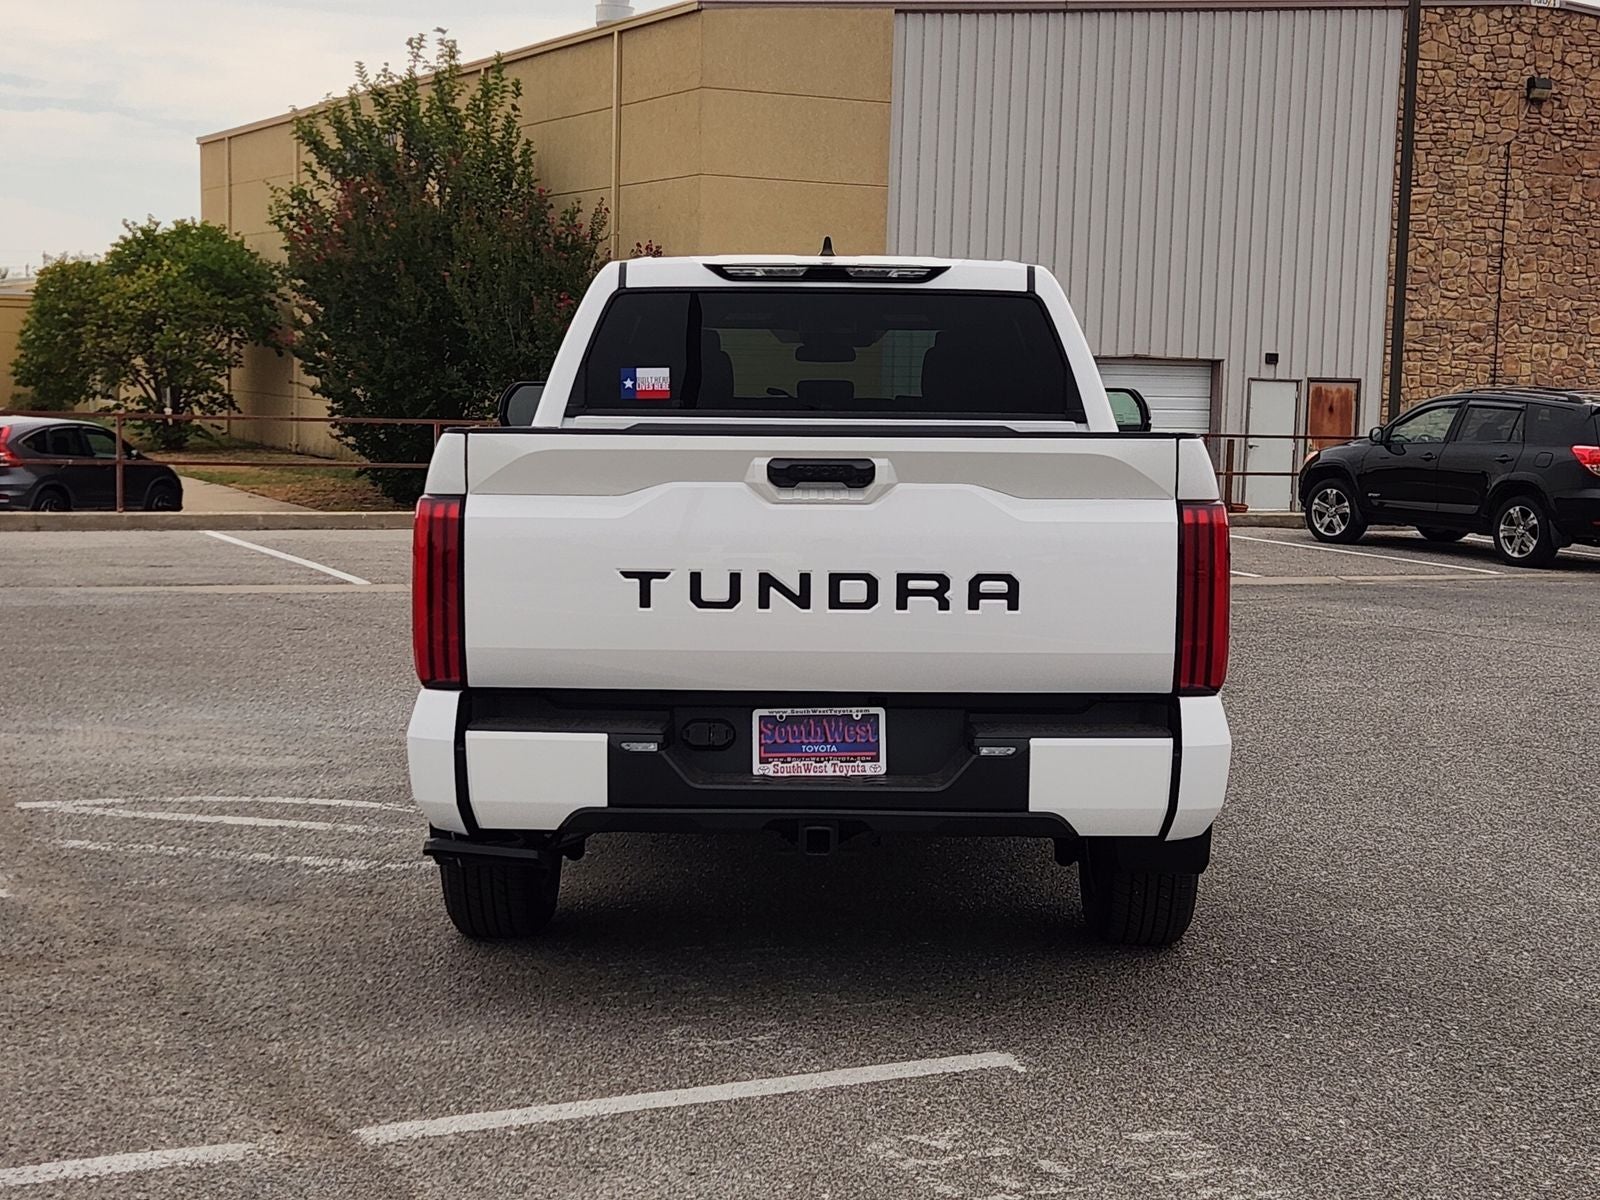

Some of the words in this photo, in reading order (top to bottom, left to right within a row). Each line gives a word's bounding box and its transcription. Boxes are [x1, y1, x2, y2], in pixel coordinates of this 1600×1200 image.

[617, 569, 1020, 612] TUNDRA
[760, 718, 879, 744] SouthWest
[801, 744, 838, 753] TOYOTA
[772, 762, 827, 775] SouthWest
[830, 762, 867, 776] Toyota
